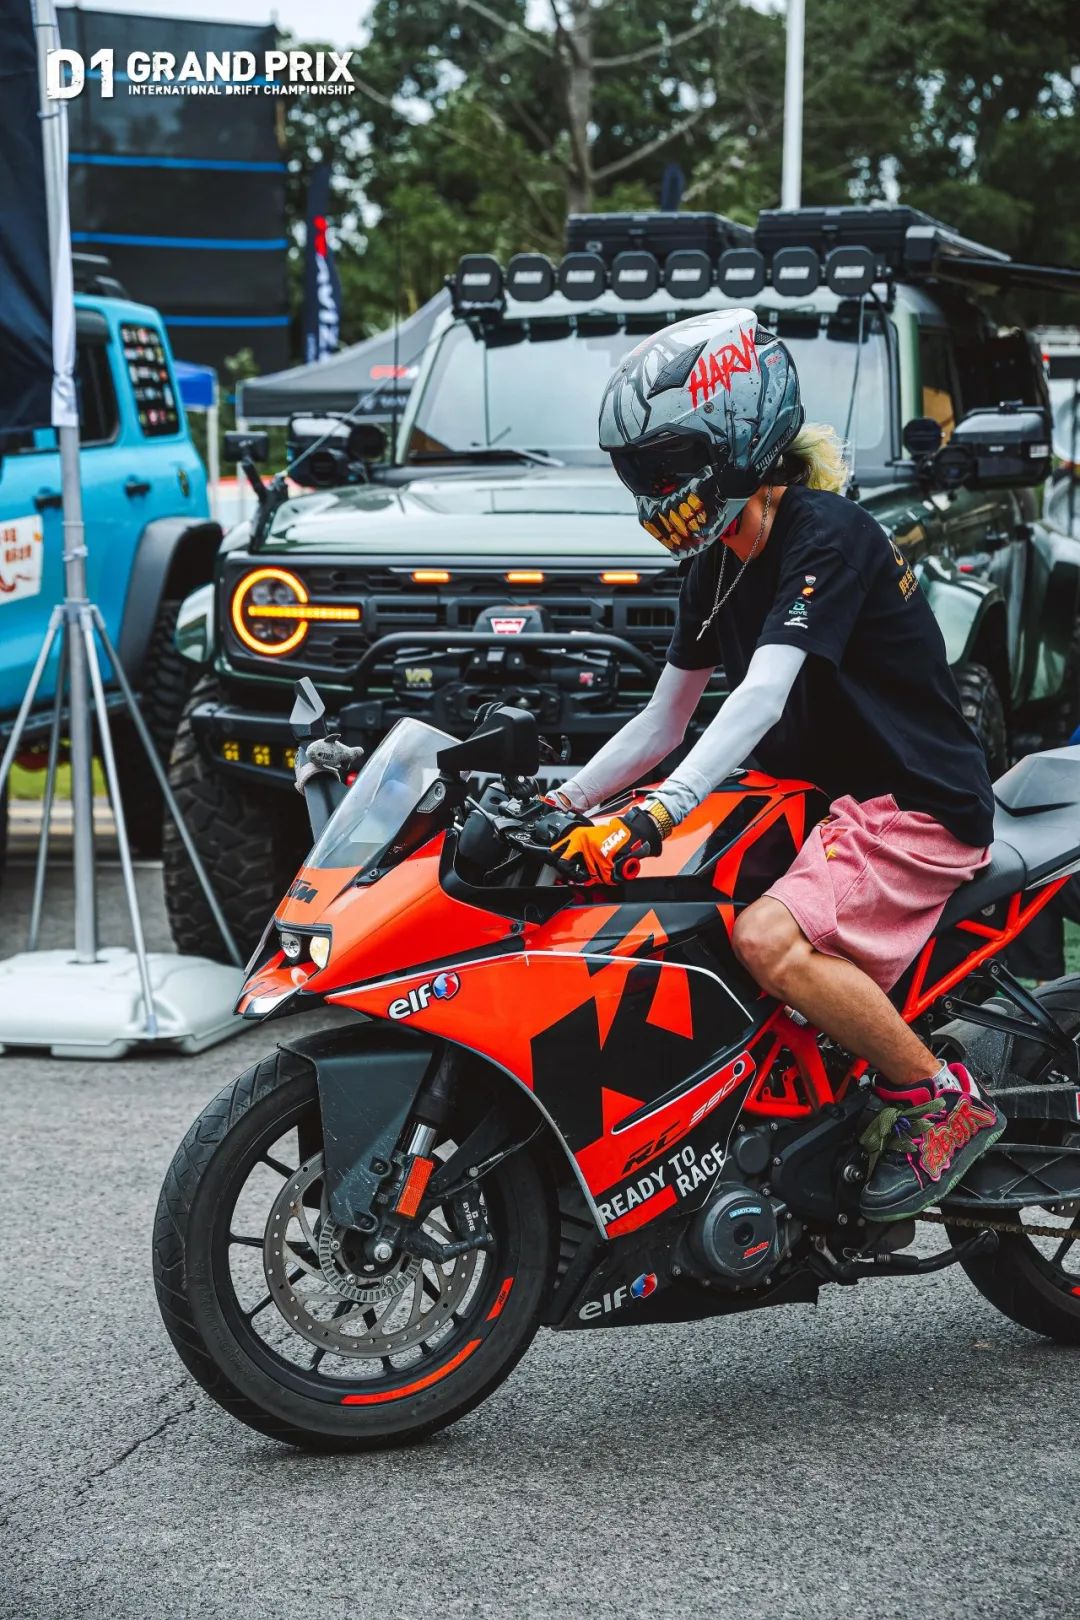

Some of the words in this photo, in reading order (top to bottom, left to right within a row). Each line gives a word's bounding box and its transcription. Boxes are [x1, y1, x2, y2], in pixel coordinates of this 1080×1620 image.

[600, 828, 627, 858] KTM
[388, 982, 432, 1020] elf
[598, 1165, 667, 1225] READY
[667, 1145, 697, 1177] TO
[676, 1141, 727, 1198] RACE
[578, 1285, 628, 1320] elf
